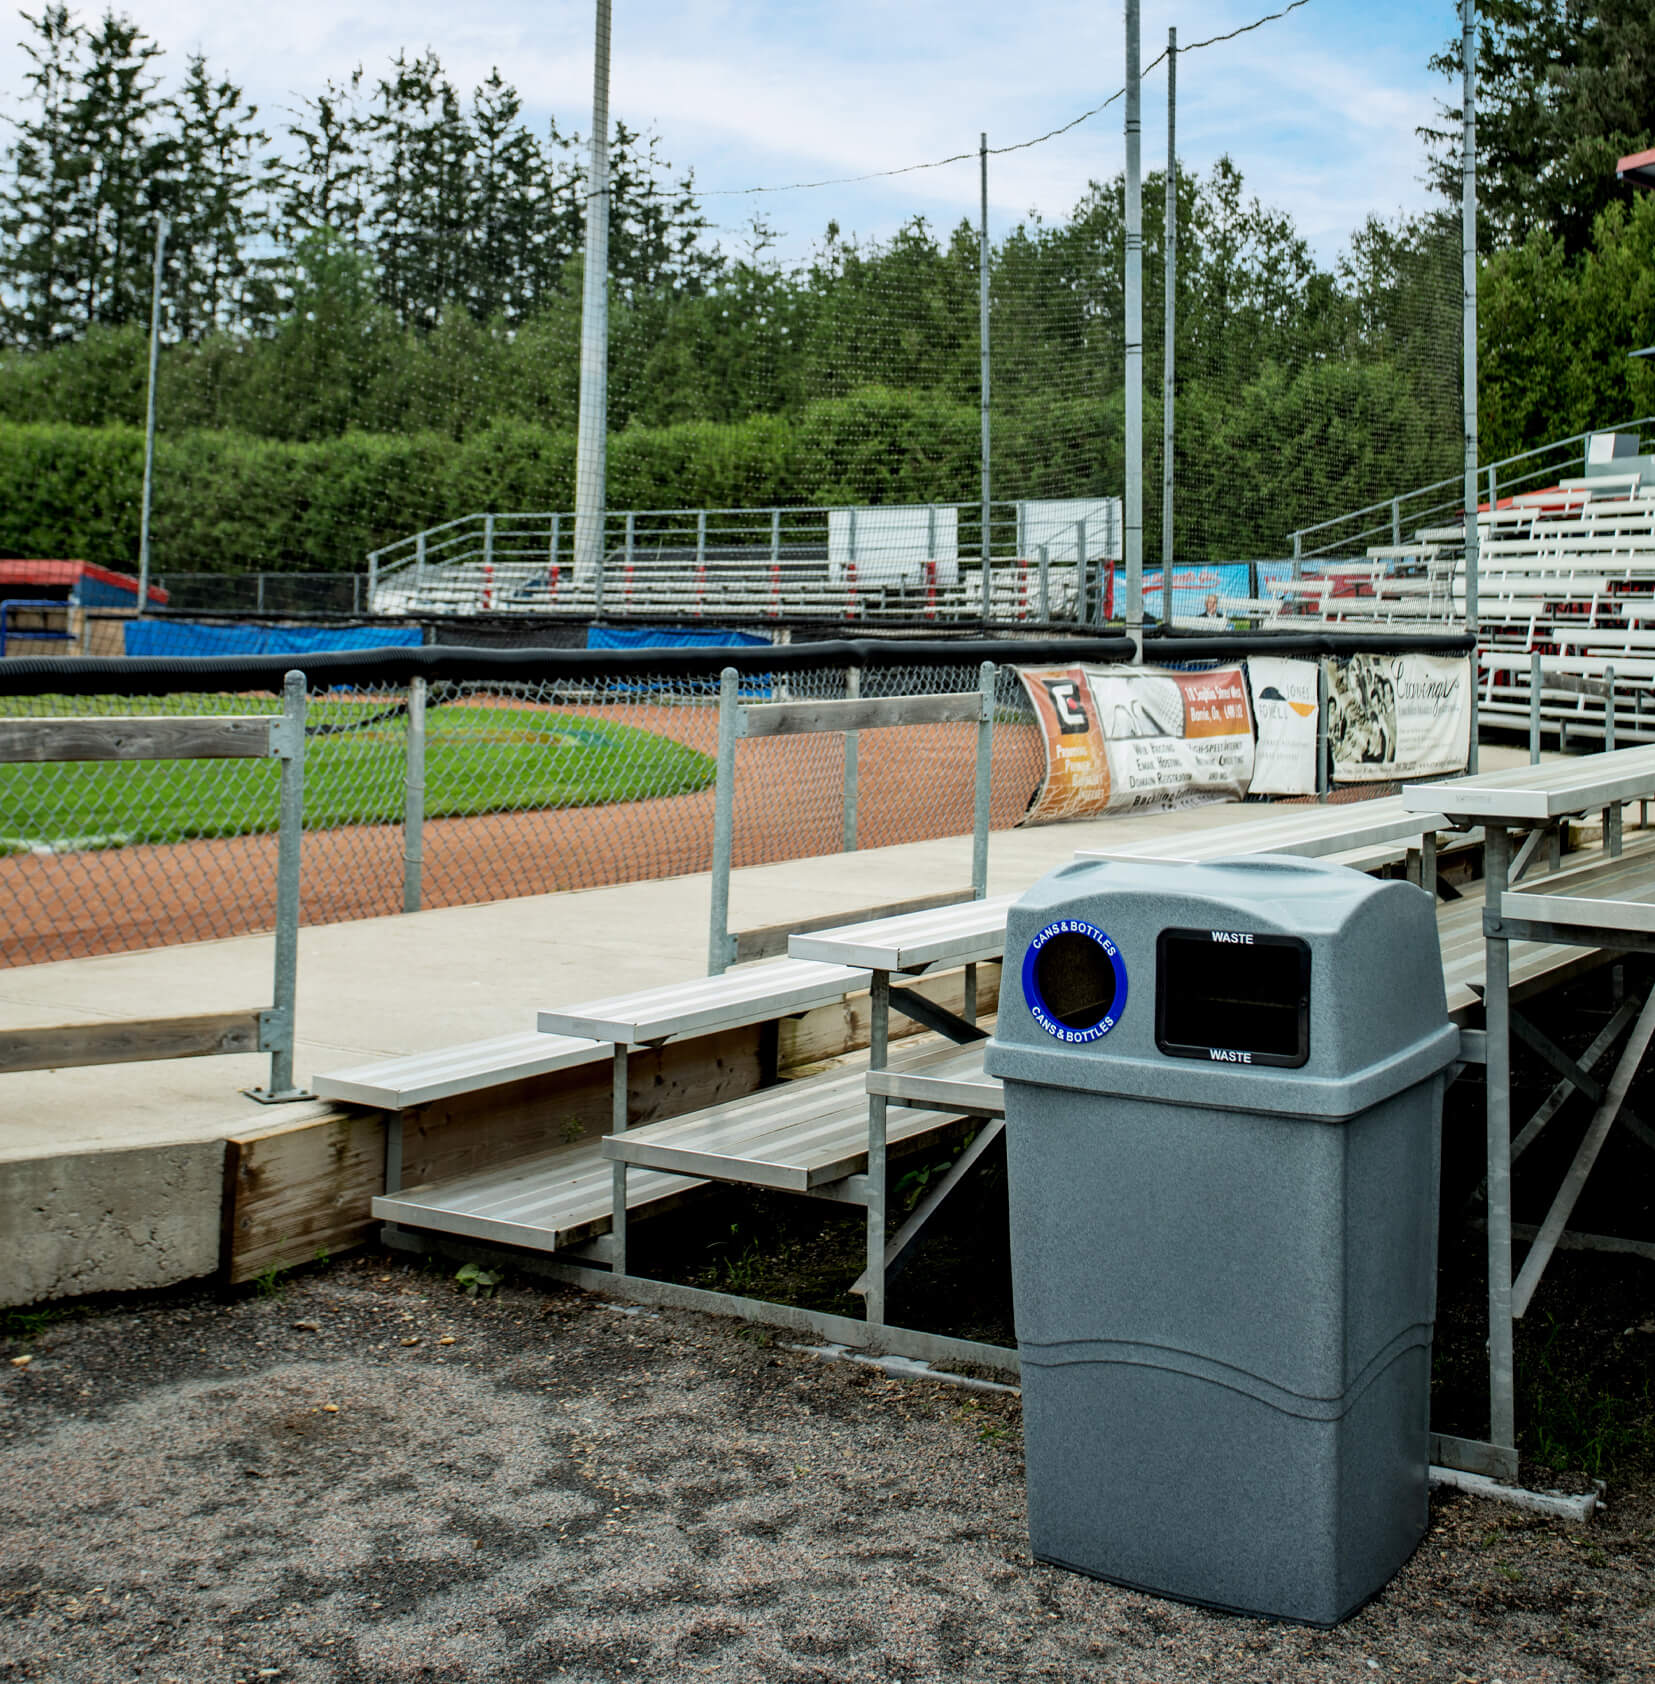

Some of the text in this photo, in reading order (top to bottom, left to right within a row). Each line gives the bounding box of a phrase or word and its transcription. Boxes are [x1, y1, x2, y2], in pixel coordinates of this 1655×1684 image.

[1391, 659, 1459, 718] Cravings
[1033, 921, 1116, 957] CANS & BOTTLES
[1211, 930, 1254, 945] WASTE
[1032, 1006, 1114, 1043] CANS & BOTTLES
[1209, 1048, 1252, 1064] WASTE
